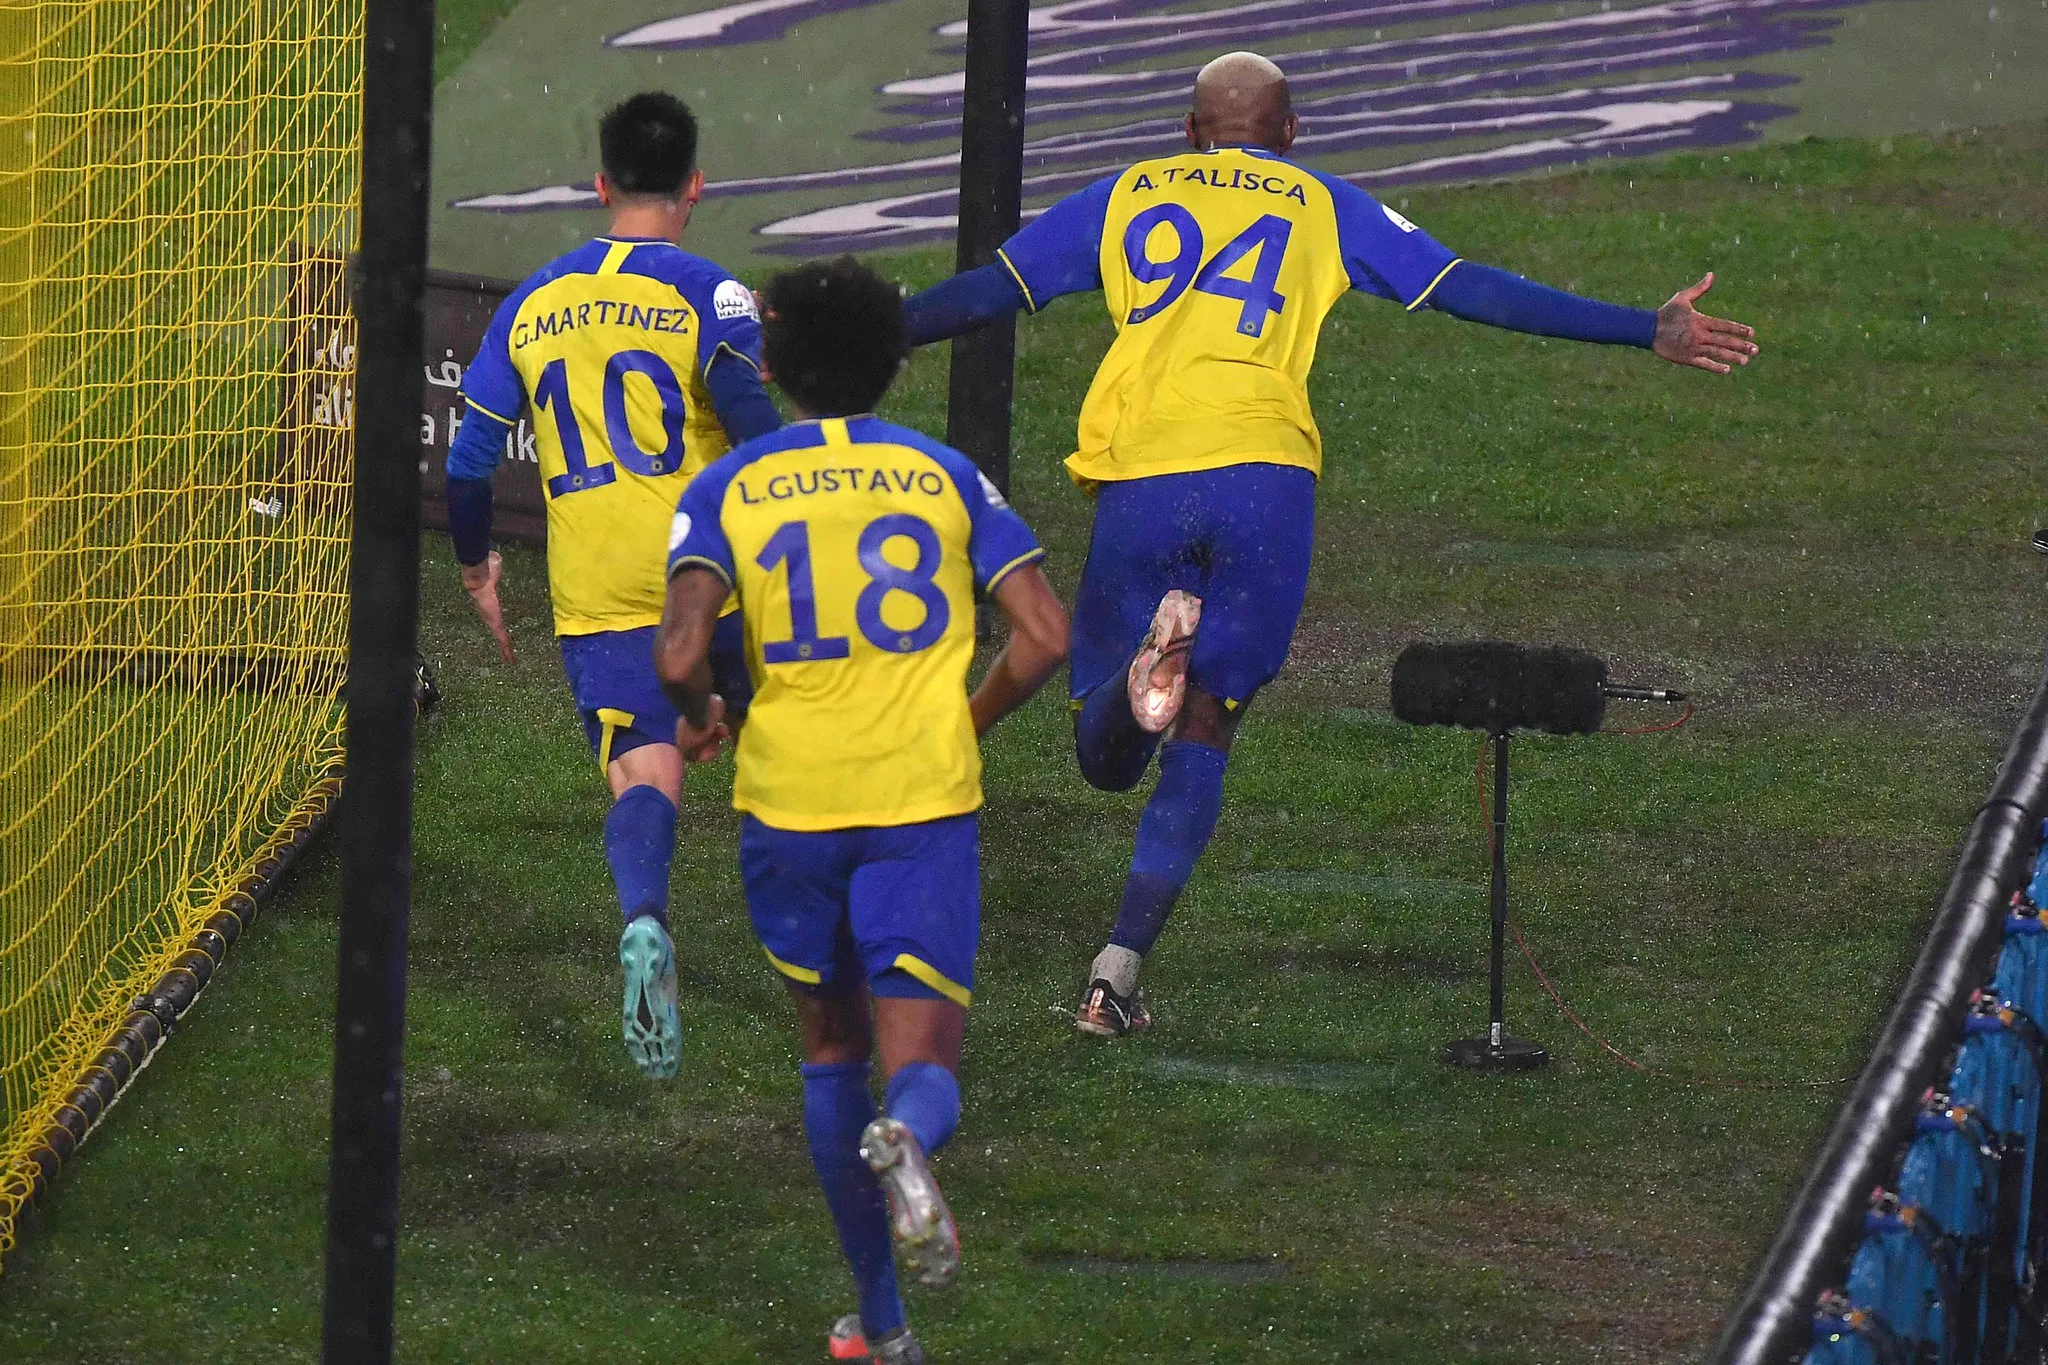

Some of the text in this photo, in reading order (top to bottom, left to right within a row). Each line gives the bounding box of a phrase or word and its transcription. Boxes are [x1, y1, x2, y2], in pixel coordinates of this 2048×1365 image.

[1131, 167, 1307, 206] A.TALISCA
[1123, 202, 1294, 338] 94
[514, 300, 691, 350] G.MARTINEZ
[533, 349, 686, 500] 10
[738, 467, 943, 505] L.GUSTAVO
[755, 512, 950, 664] 18
